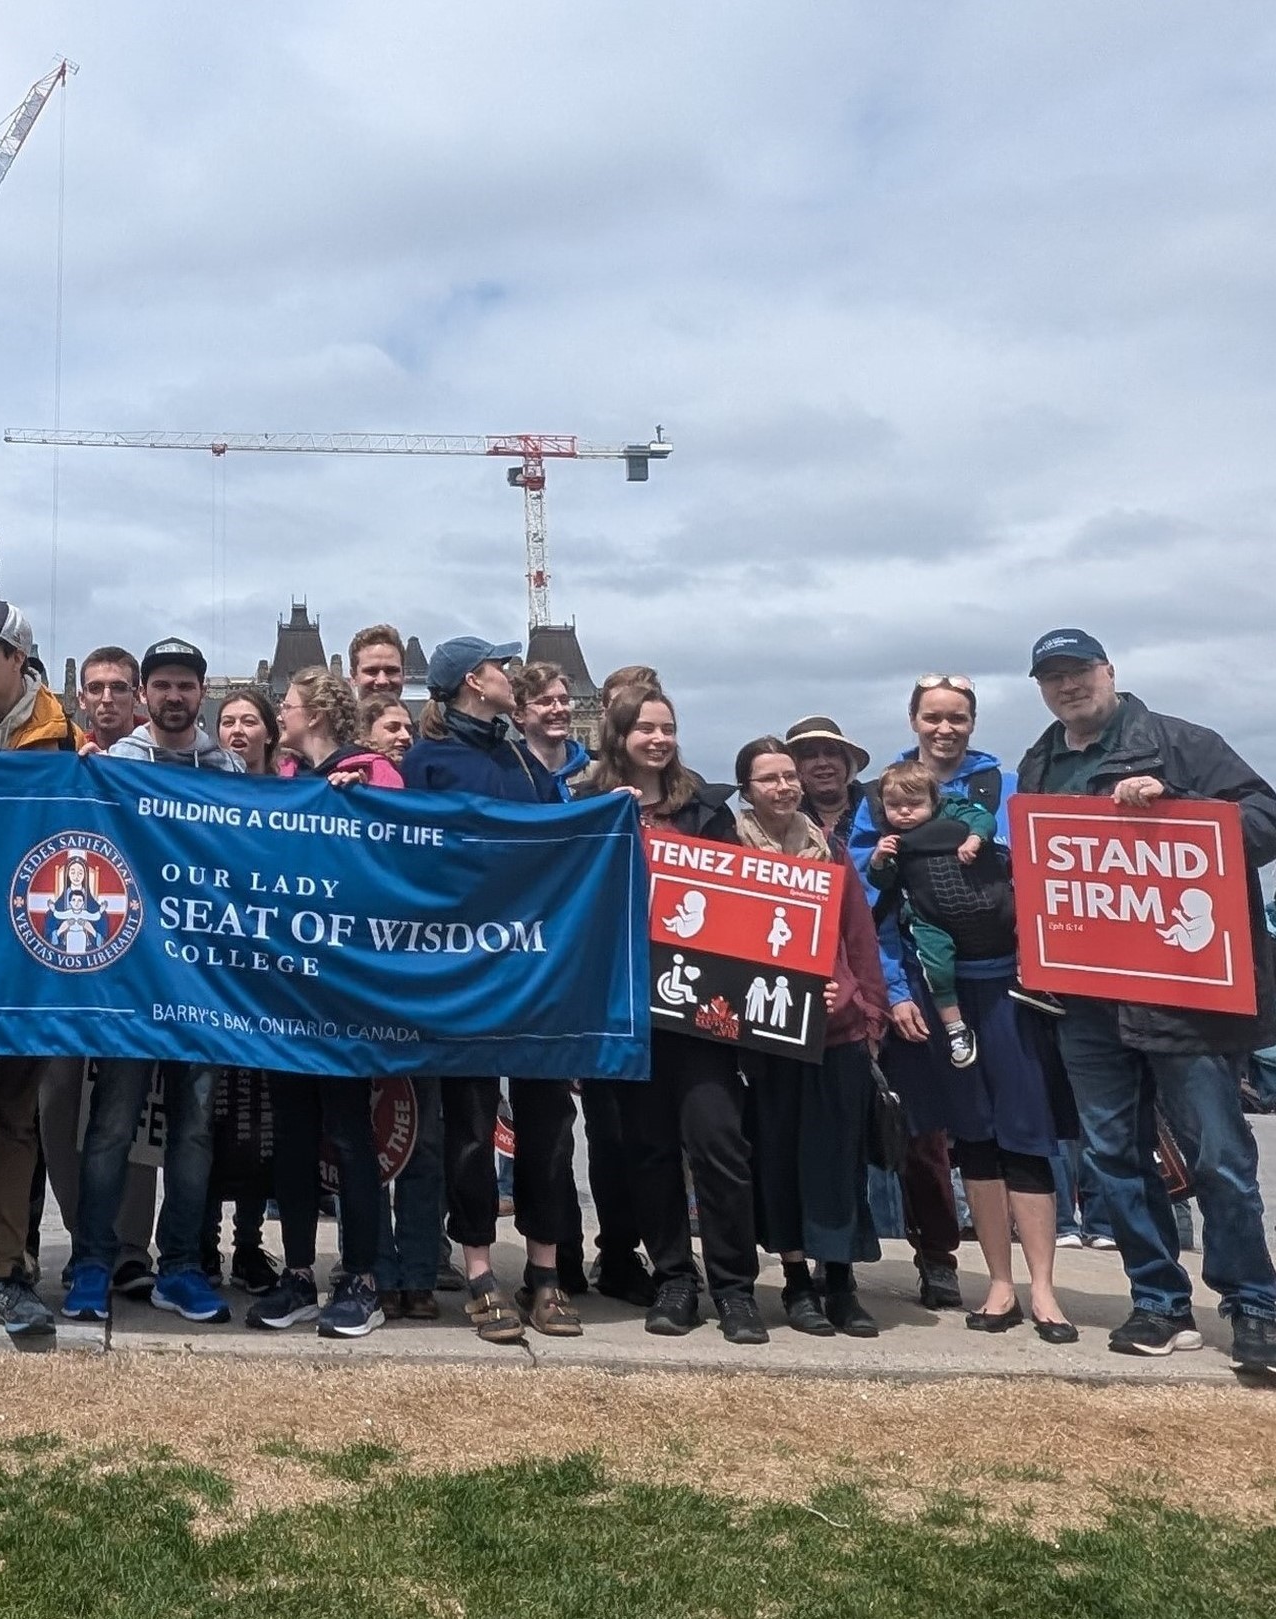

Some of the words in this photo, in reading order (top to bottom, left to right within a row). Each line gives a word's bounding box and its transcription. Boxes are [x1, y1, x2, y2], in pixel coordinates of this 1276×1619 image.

[137, 797, 241, 826] BUILDING
[246, 810, 263, 829] A
[268, 811, 362, 839] CULTURE
[367, 821, 397, 842] OF
[402, 825, 444, 847] LIFE
[20, 842, 57, 882] SEDES
[59, 835, 134, 886] SAPIENTIAE
[161, 863, 231, 888] OUR
[250, 871, 340, 899] LADY
[649, 839, 736, 876] TENEZ
[741, 857, 831, 895] FERME
[1046, 835, 1209, 879] STAND
[159, 896, 279, 941] SEAT
[291, 910, 356, 947] OF
[367, 917, 547, 954] WISDOM
[1044, 879, 1166, 924] FIRM
[15, 912, 54, 962] VERITAS
[57, 954, 82, 968] VOS
[86, 914, 139, 967] LIBERABIT
[164, 940, 320, 977] COLLEGE
[152, 1003, 220, 1027] BARRY'S
[223, 1013, 254, 1035] BAY,
[259, 1016, 341, 1041] ONTARIO,
[346, 1023, 421, 1043] CANADA
[386, 1099, 411, 1153] THEE
